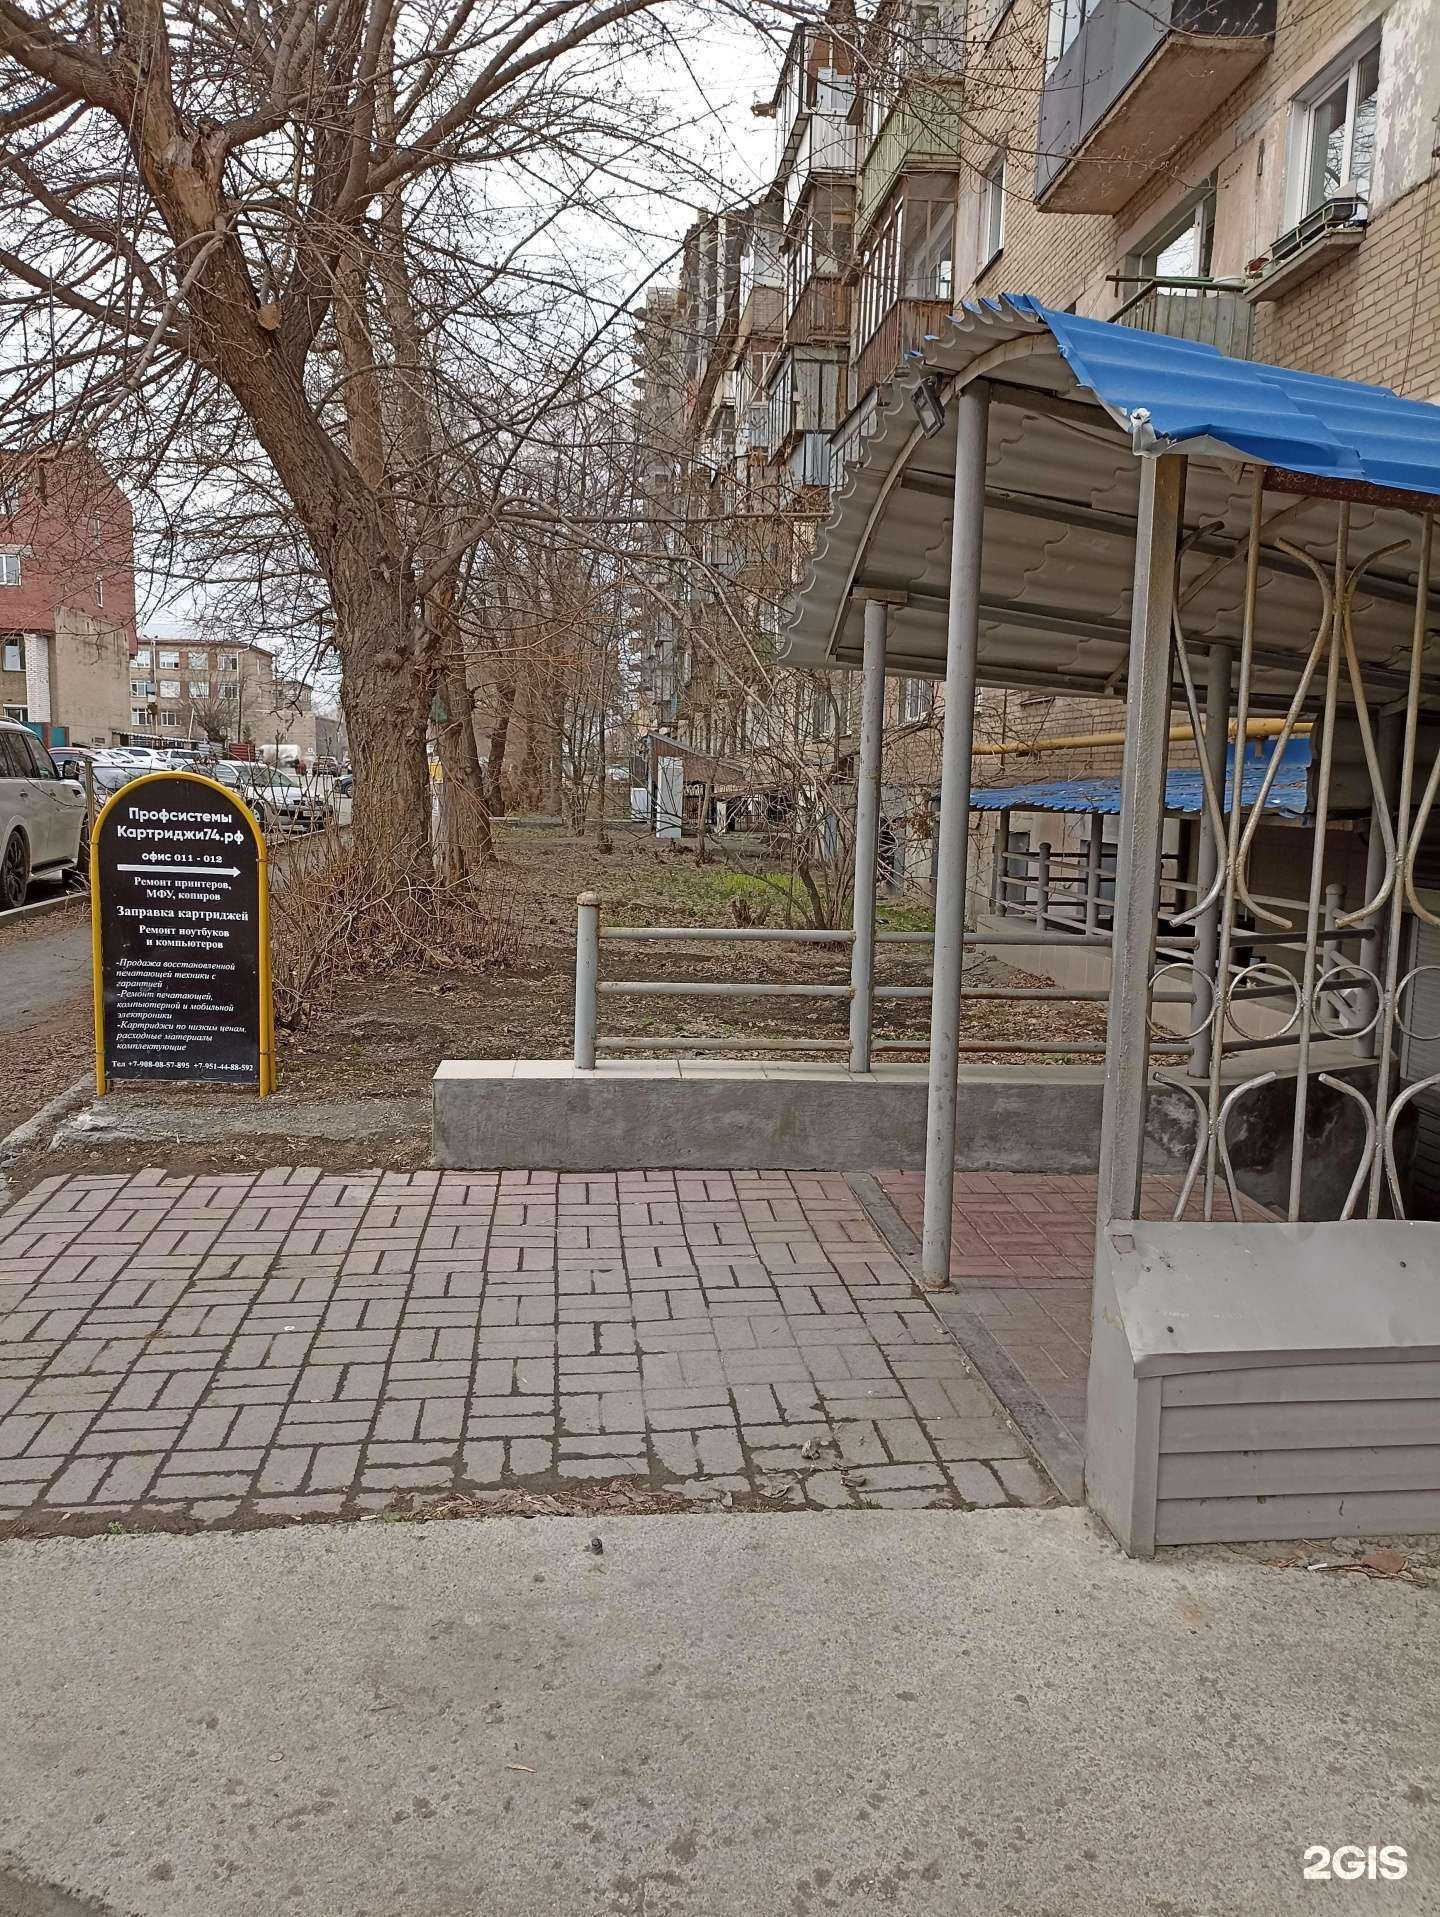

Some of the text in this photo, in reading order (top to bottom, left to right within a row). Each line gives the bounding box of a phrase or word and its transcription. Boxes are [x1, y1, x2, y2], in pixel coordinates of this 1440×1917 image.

[129, 807, 232, 823] Профсистемы
[117, 825, 244, 844] Картриджи74.рф
[142, 851, 171, 862] офис
[174, 854, 193, 862] 011
[203, 855, 223, 863] 012
[134, 877, 232, 891] Ремонт принтеров,
[146, 889, 221, 902] МФУ, копиров
[116, 906, 249, 921] Заправка картриджей
[139, 925, 230, 938] Ремонт ноутбуков
[155, 940, 224, 950] компьютеров
[163, 962, 236, 971] восстановленной
[116, 970, 172, 979] печатающей
[116, 981, 163, 989] гарантией
[116, 1002, 181, 1011] компьютерной
[189, 1004, 234, 1012] мобильной
[117, 1012, 172, 1020] электроники
[116, 1032, 162, 1041] расходные
[116, 1043, 187, 1051] комплектующие
